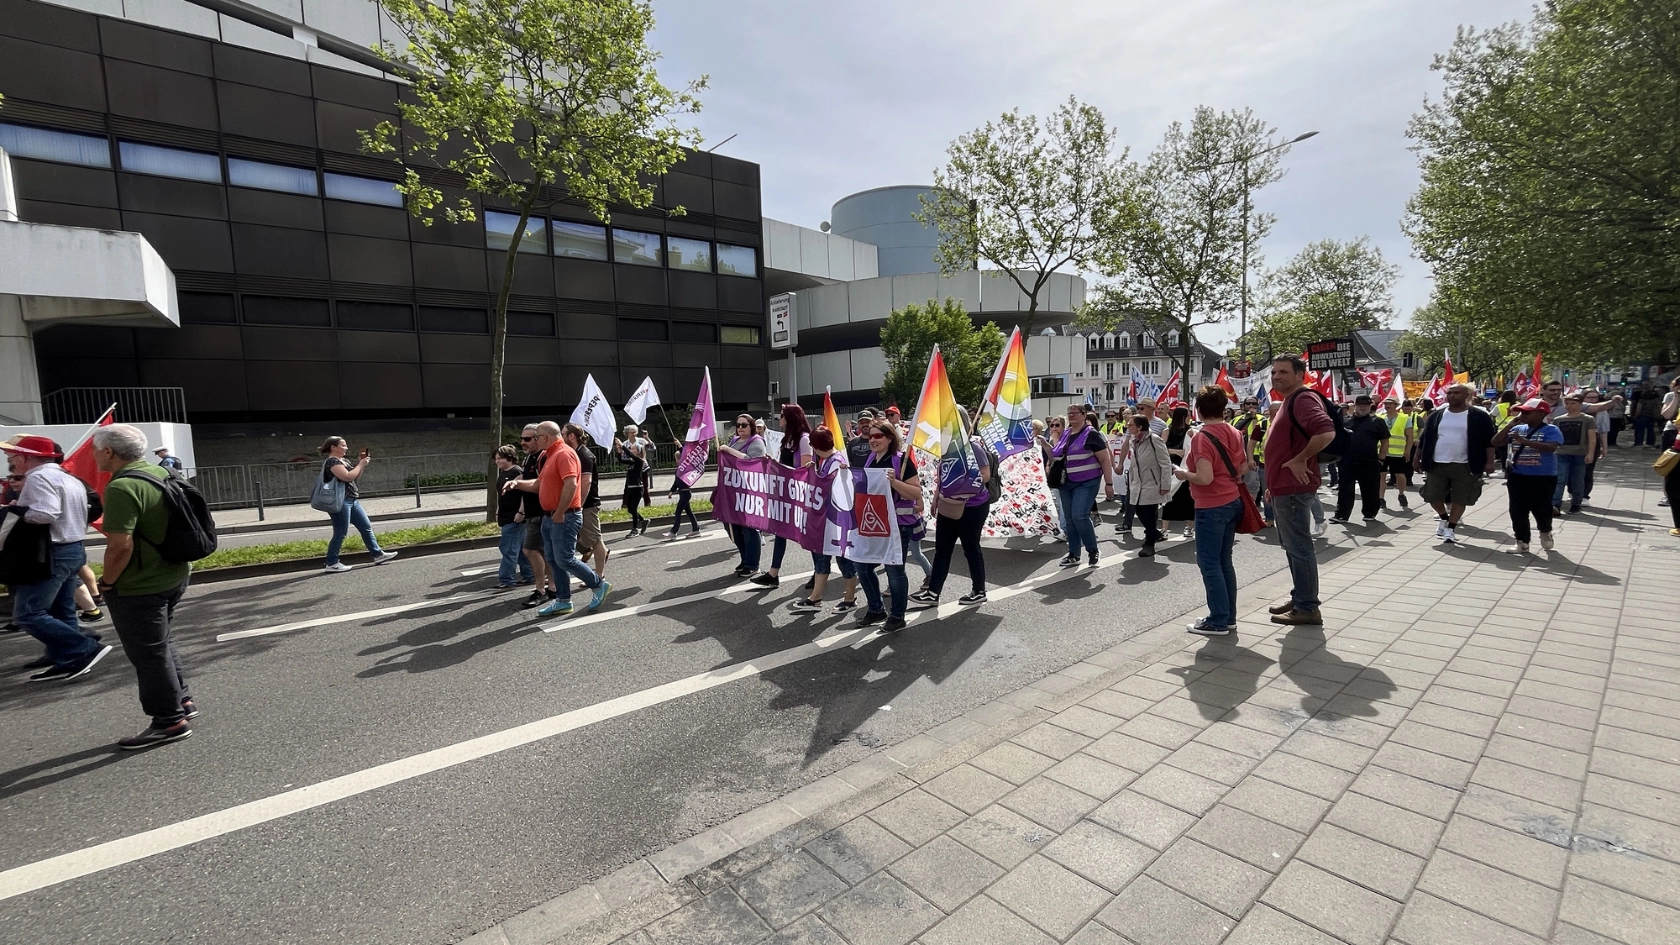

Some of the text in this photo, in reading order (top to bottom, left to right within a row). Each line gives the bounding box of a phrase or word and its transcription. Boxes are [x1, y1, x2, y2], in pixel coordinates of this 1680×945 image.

[1312, 342, 1350, 352] GEGEN DIE
[1312, 351, 1350, 360] ABWERTUNG
[1329, 358, 1350, 367] WELT
[723, 466, 786, 497] ZUKUNFT
[734, 491, 765, 518] NUR
[767, 498, 792, 524] MIT
